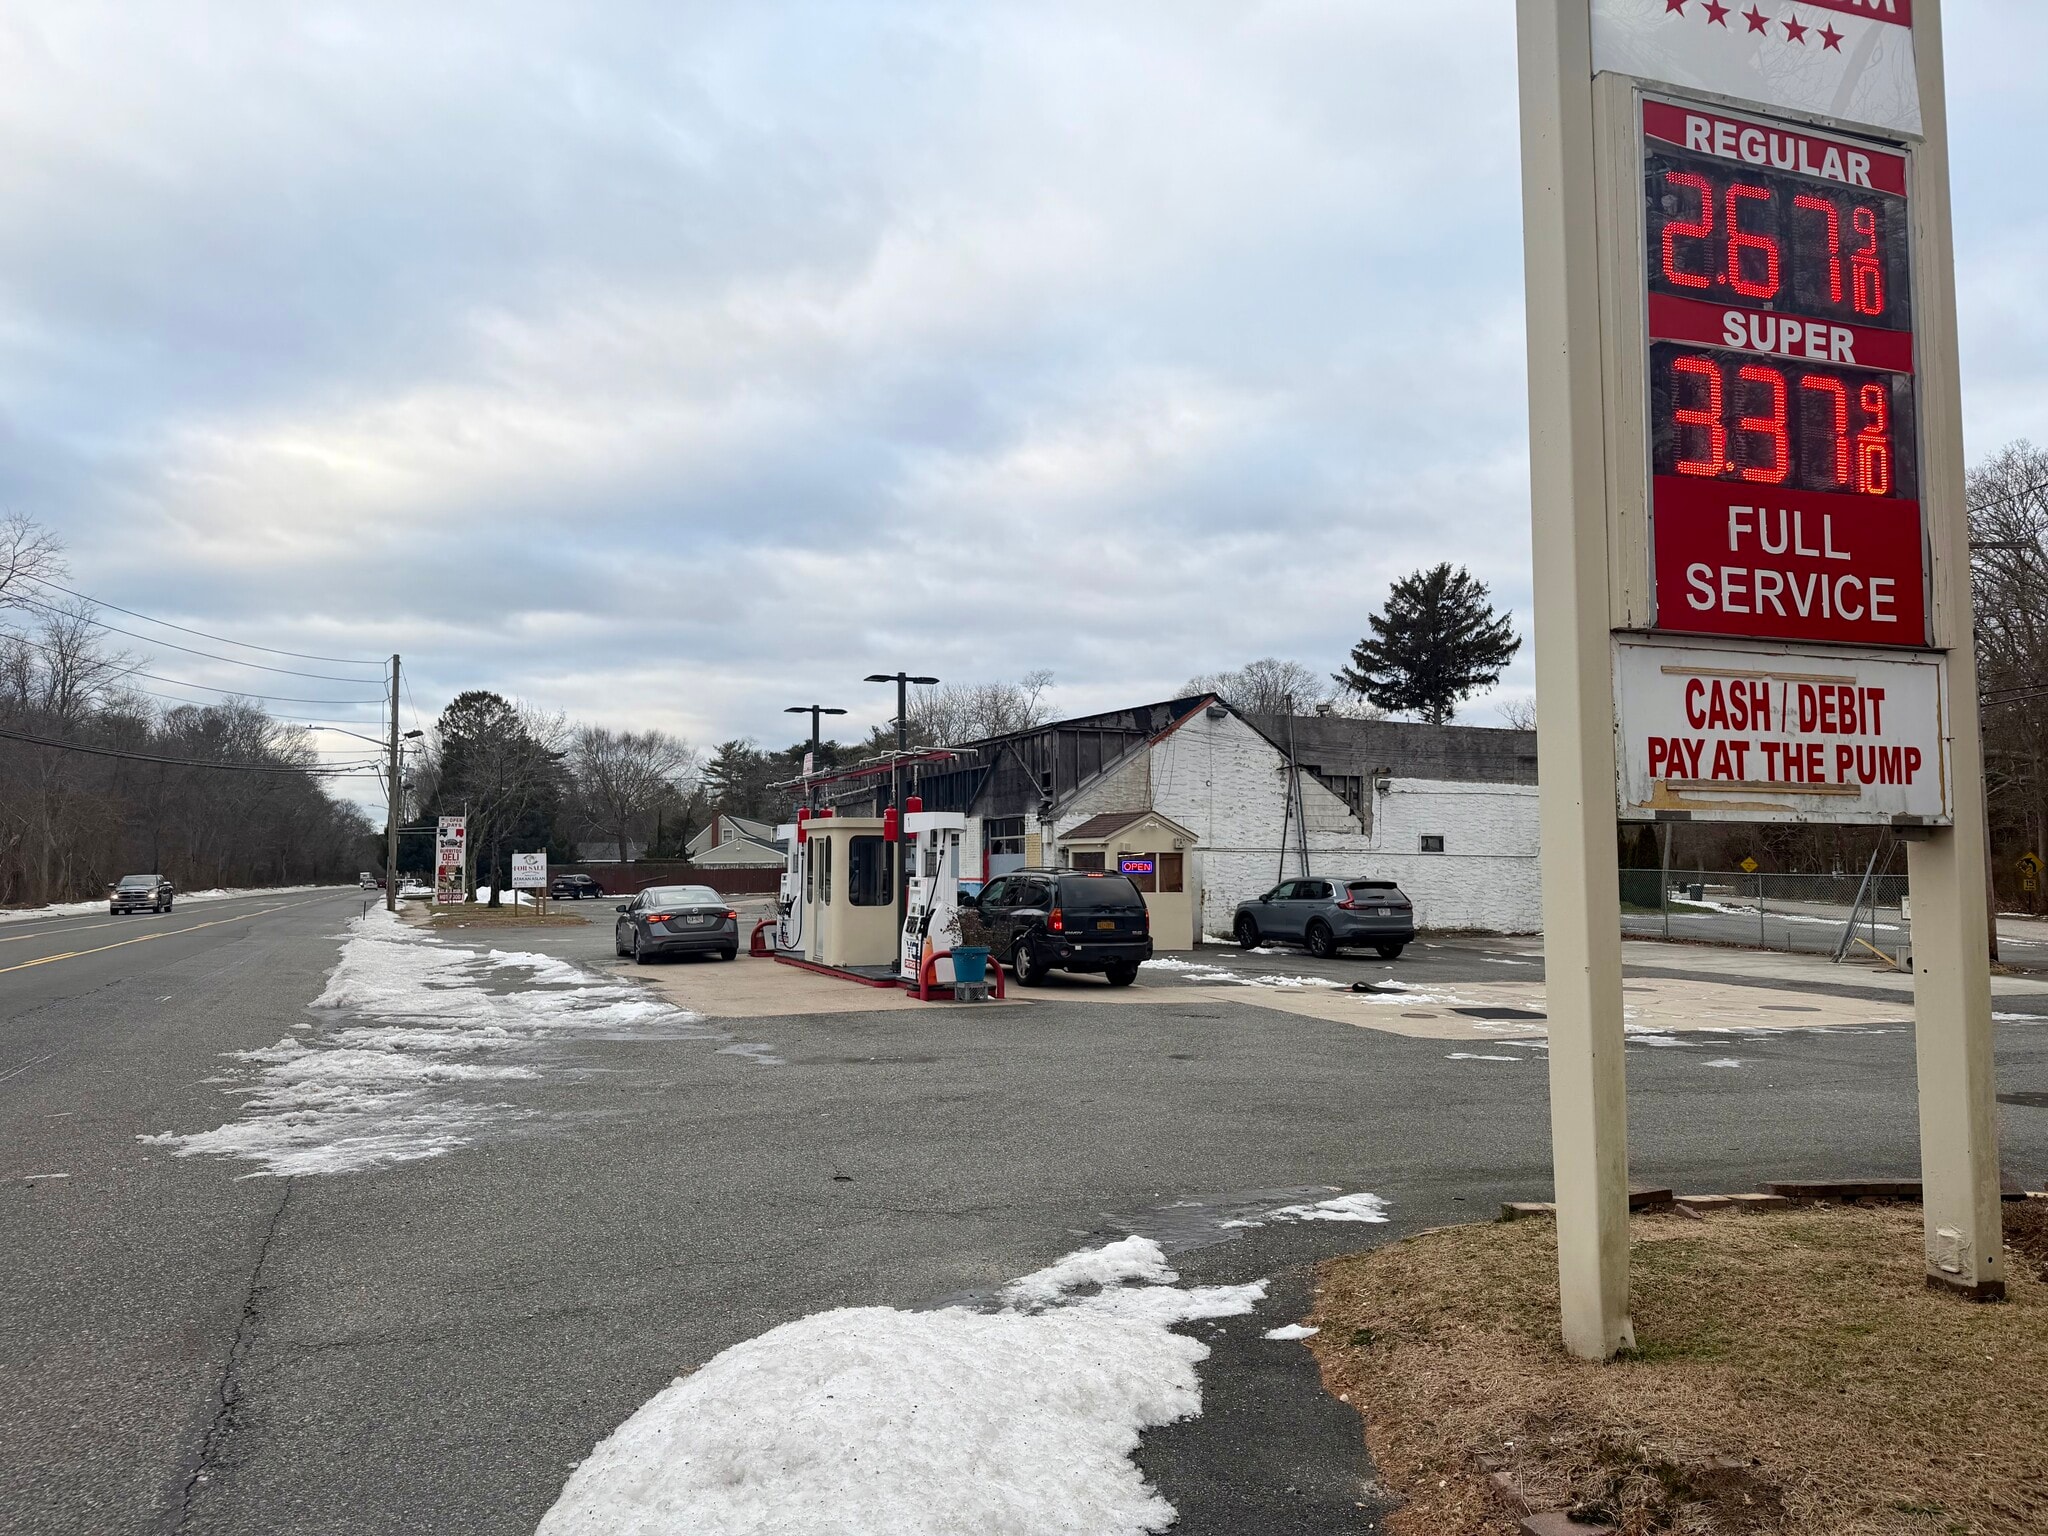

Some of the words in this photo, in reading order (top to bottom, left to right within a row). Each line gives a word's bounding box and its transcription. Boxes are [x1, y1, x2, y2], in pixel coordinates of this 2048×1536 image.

[1685, 114, 1872, 188] REGULAR
[1662, 171, 1842, 303] 2.67
[1722, 310, 1856, 363] SUPER
[1673, 355, 1847, 485] 3.37
[1728, 505, 1851, 560] FULL
[1686, 562, 1898, 622] SERVICE
[1685, 677, 1772, 731] CASH
[1797, 683, 1886, 735] DEBIT
[1647, 736, 1706, 779] PAY
[1711, 739, 1750, 781] AT
[1761, 741, 1825, 782] THE
[1836, 743, 1922, 786] PUMP
[442, 853, 460, 861] DELI
[1124, 862, 1151, 871] OPEN
